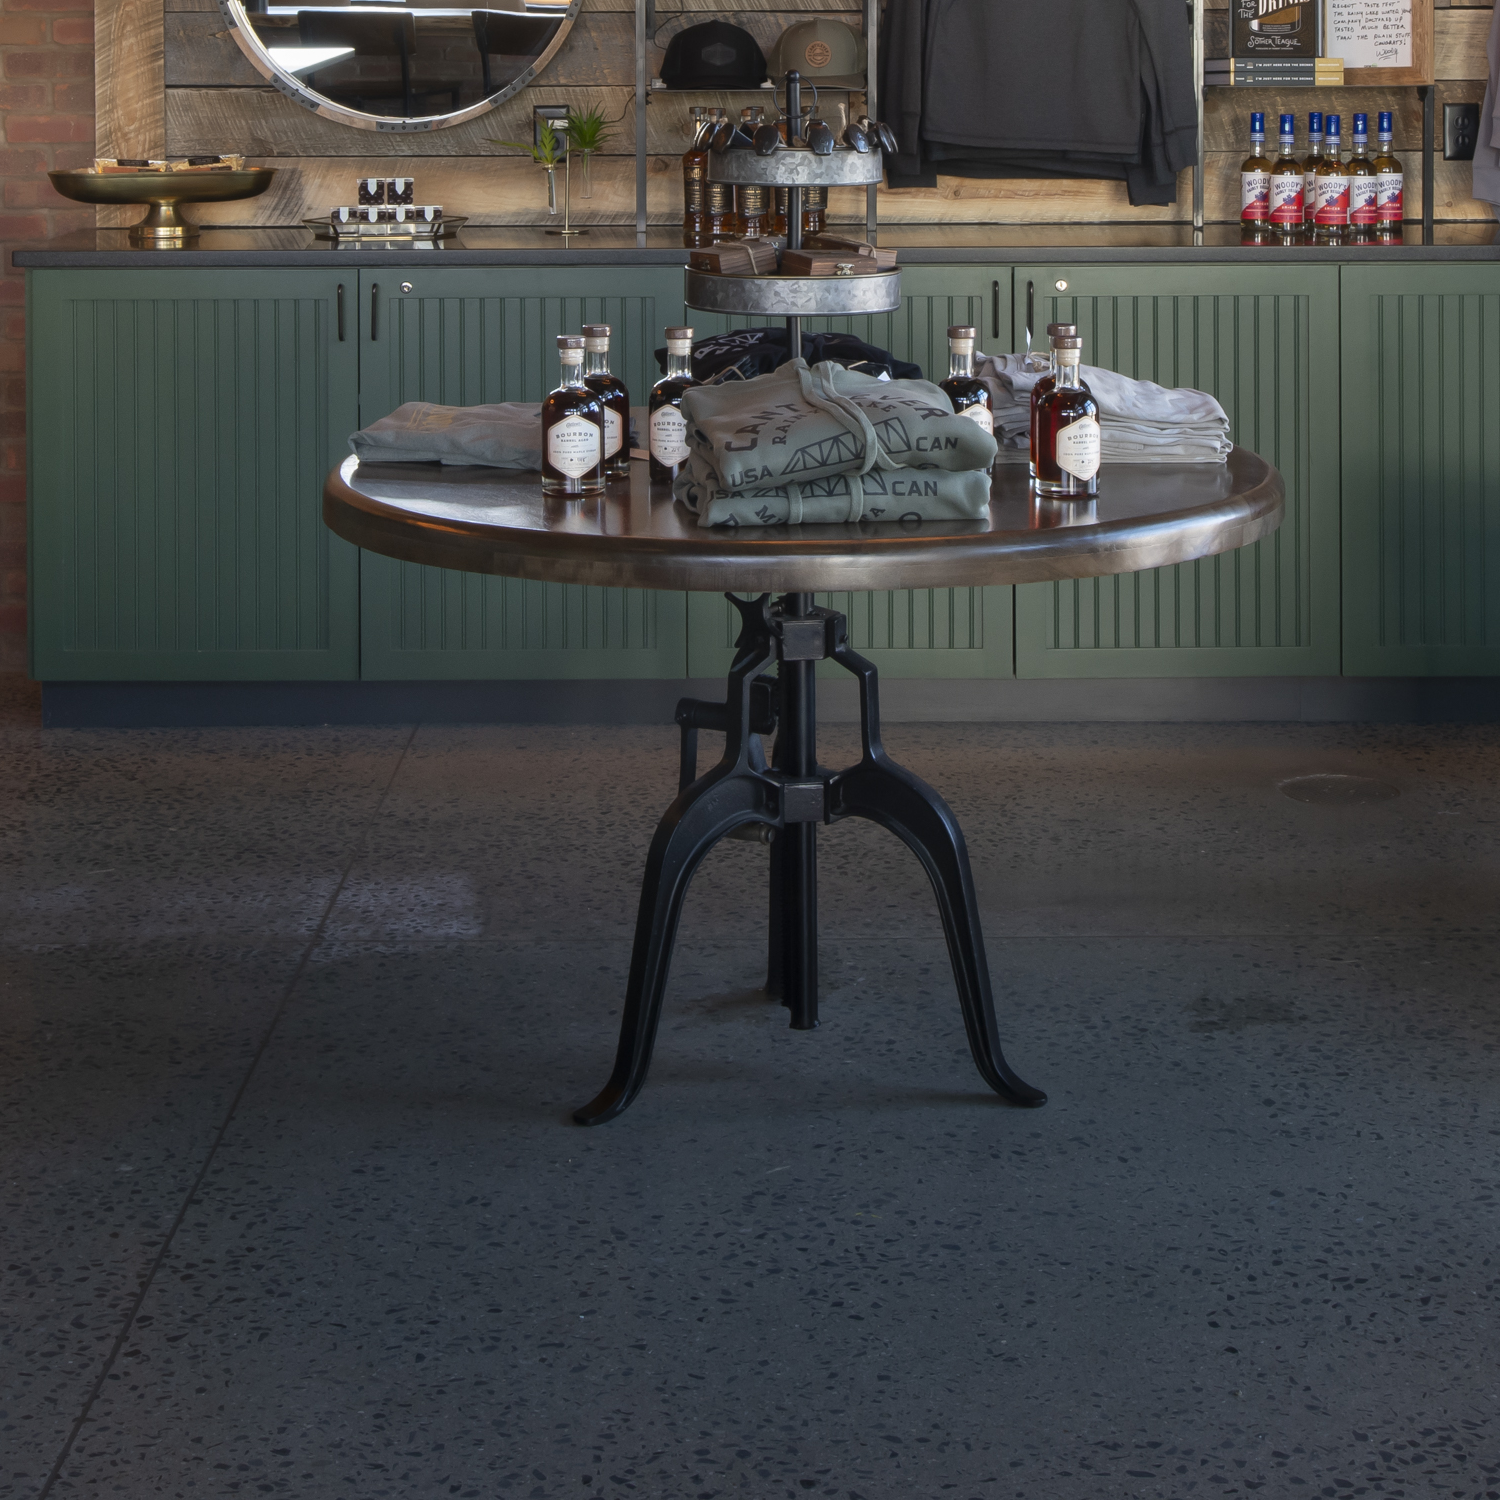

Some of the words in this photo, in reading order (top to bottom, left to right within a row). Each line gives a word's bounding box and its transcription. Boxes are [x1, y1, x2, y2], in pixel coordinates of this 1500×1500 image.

[1240, 0, 1257, 8] FOR
[1238, 8, 1255, 19] THE
[731, 465, 773, 487] USA
[915, 436, 959, 452] CAN
[891, 480, 938, 497] CAN
